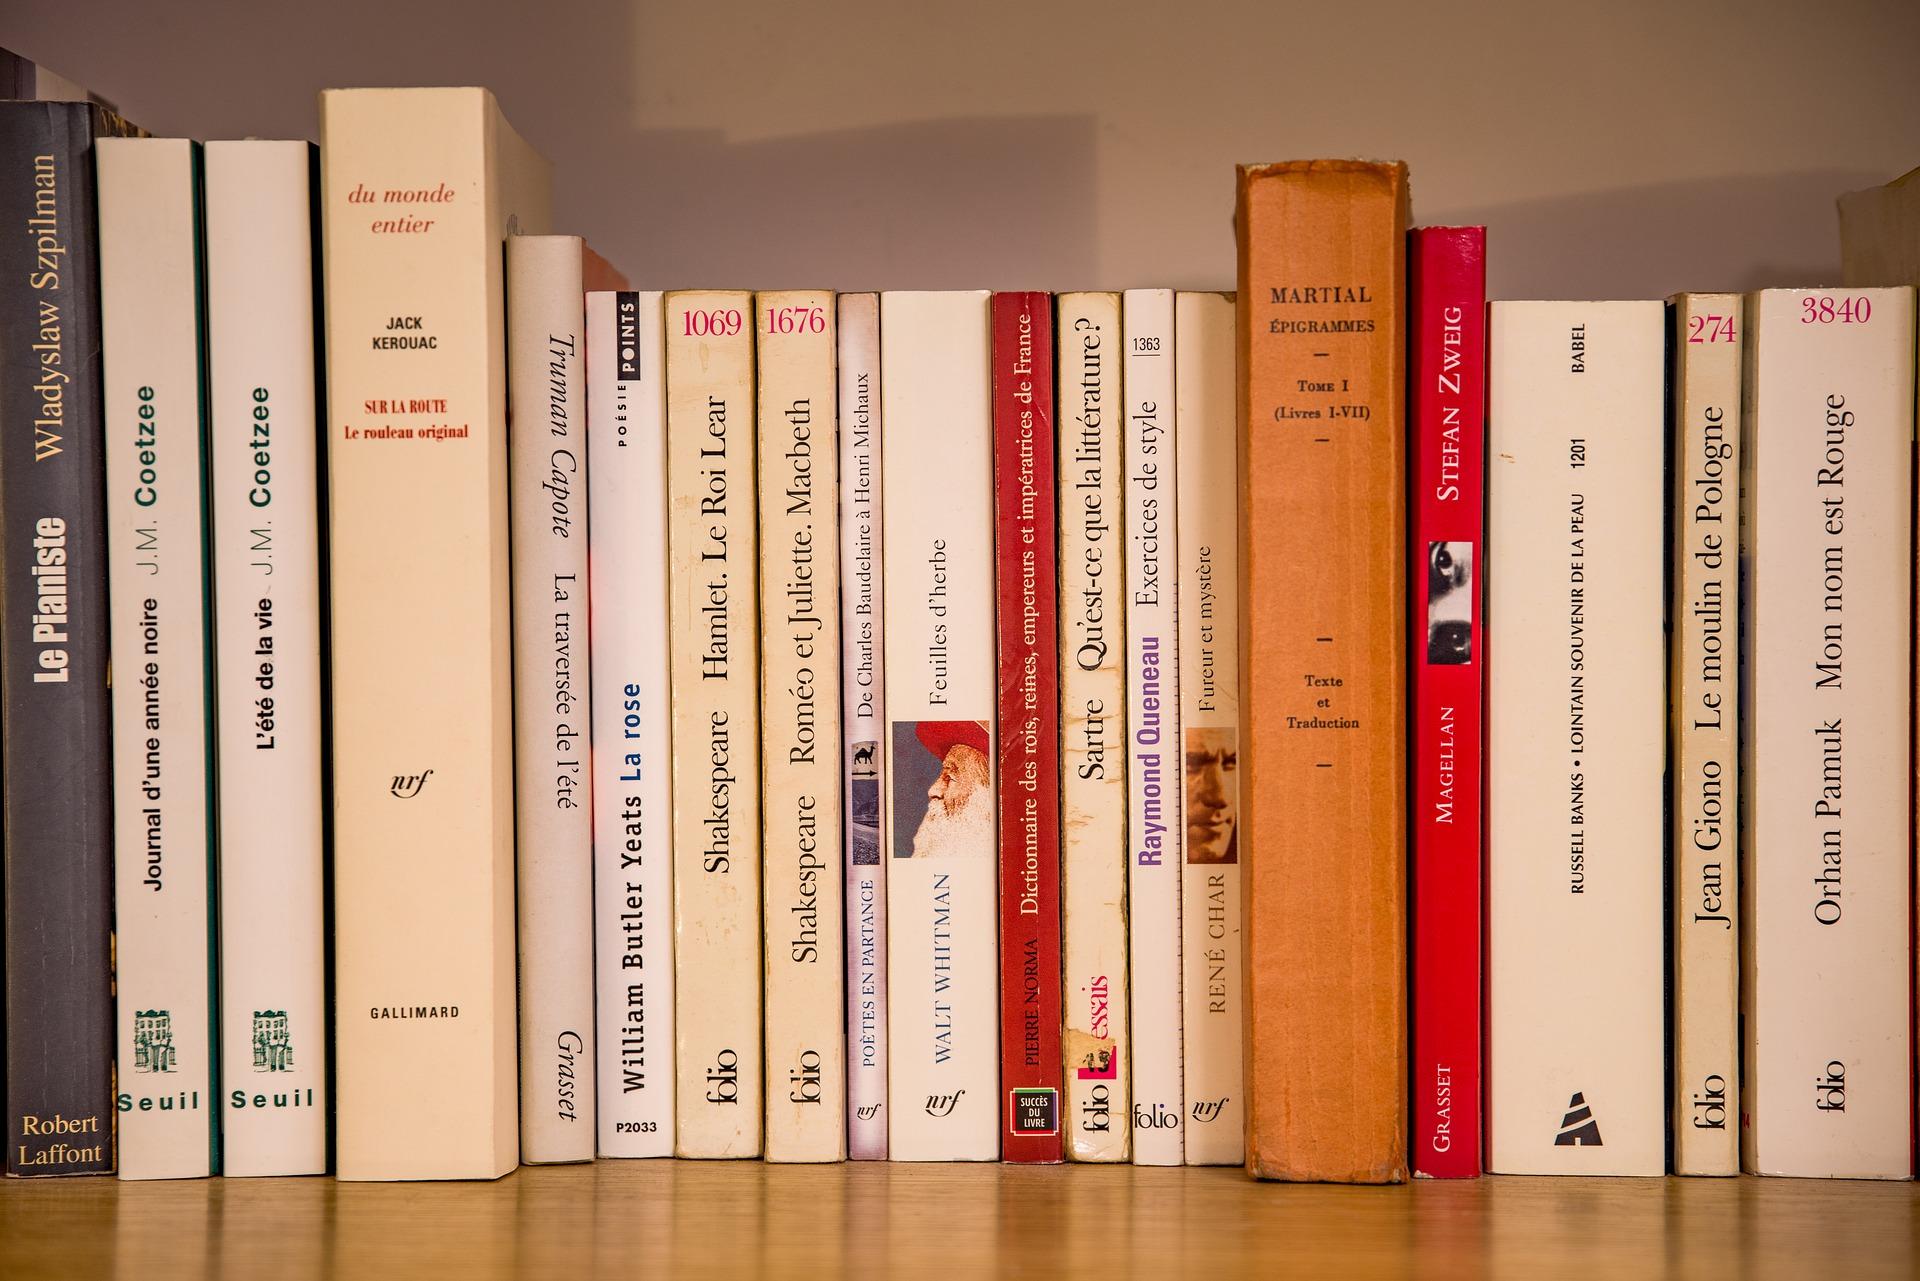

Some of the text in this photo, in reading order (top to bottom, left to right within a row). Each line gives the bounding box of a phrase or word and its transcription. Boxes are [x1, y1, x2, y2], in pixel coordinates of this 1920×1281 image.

[349, 183, 454, 203] du monde
[372, 215, 434, 233] entier
[29, 156, 69, 461] Wladyslaw Szpilman
[1271, 287, 1371, 303] MARTIAL
[1802, 297, 1871, 323] 3840
[372, 336, 437, 350] KEROUAC
[386, 316, 423, 330] JACK
[620, 302, 636, 372] POINTS
[684, 310, 741, 336] 1069
[766, 308, 826, 334] 1676
[1133, 337, 1161, 351] 1363
[1270, 318, 1376, 333] ÉPIGRAMMES
[1687, 314, 1737, 344] 274
[1571, 323, 1585, 373] BABEL
[364, 400, 448, 414] SUR LA ROUTE
[1342, 379, 1349, 392] I
[1437, 307, 1461, 500] STEFAN ZWEIG
[345, 424, 469, 442] Le rouleau original
[615, 384, 629, 447] POÉSIE
[1275, 406, 1370, 421] (Livres I-VII)
[1571, 440, 1585, 468] 1201
[249, 387, 274, 749] L’été de la vie J.M. Coetzee
[854, 374, 872, 717] De Charles Baudelaire à Henri Michaux
[1075, 318, 1108, 779] Sartre Qu’est-ce que la littérature?
[543, 334, 579, 808] Truman Capote La traversée de l’été
[32, 517, 69, 683] Le Pianiste
[929, 540, 947, 704] Feuilles d’herbe
[1014, 315, 1040, 914] Dictionnaire des rois, reines, empereurs et impératrices de France
[134, 386, 161, 891] Journal d’une année noire J.M. Coetzee
[701, 396, 735, 873] Shakespeare Hamlet. Le Roi Lear
[1132, 401, 1167, 866] Raymond Queneau Exercices de style
[1199, 547, 1216, 710] Fureur et mystère
[785, 399, 825, 962] Shakespeare Roméo et Juliette. Macbeth
[1304, 674, 1344, 688] Texte
[1694, 407, 1732, 929] Jean Giono Le moulin de Pologne
[1815, 395, 1854, 925] Orhan Pamuk Mon nom est Rouge
[1316, 698, 1331, 708] et
[1570, 493, 1584, 893] RUSSELL BANKS LOINTAIN SOUVENIR DE LA PEAU
[1286, 716, 1360, 729] Traduction
[391, 770, 433, 798] nrf
[1436, 708, 1453, 823] MAGELLAN
[620, 684, 645, 1094] William Butler Yeats La rose
[1203, 874, 1226, 1014] RENÉ CHAR
[859, 879, 875, 1067] POÈTES EN PARTANCE
[934, 875, 951, 1064] WALT WHITMAN
[370, 1006, 459, 1020] GALLIMARD
[1023, 937, 1040, 1066] PIERRE NORMA
[1082, 976, 1108, 1040] essais
[231, 1088, 313, 1108] Seuil
[558, 1031, 582, 1122] Grasset
[707, 1049, 737, 1105] folio
[790, 1051, 820, 1104] folio
[1817, 1061, 1845, 1112] folio
[23, 1115, 98, 1135] Robert
[117, 1091, 198, 1112] Seuil
[857, 1104, 881, 1120] nrf
[926, 1090, 965, 1116] nrf
[1020, 1096, 1048, 1107] SUCCÈS
[1025, 1119, 1045, 1128] LIVRE
[1029, 1108, 1040, 1116] DU
[1083, 1085, 1109, 1133] folio
[1133, 1102, 1180, 1129] folio
[1193, 1098, 1229, 1122] nrf
[1433, 1064, 1450, 1152] GRASSET
[1694, 1075, 1725, 1130] folio
[616, 1121, 657, 1133] P2033
[19, 1144, 101, 1165] Laffont
